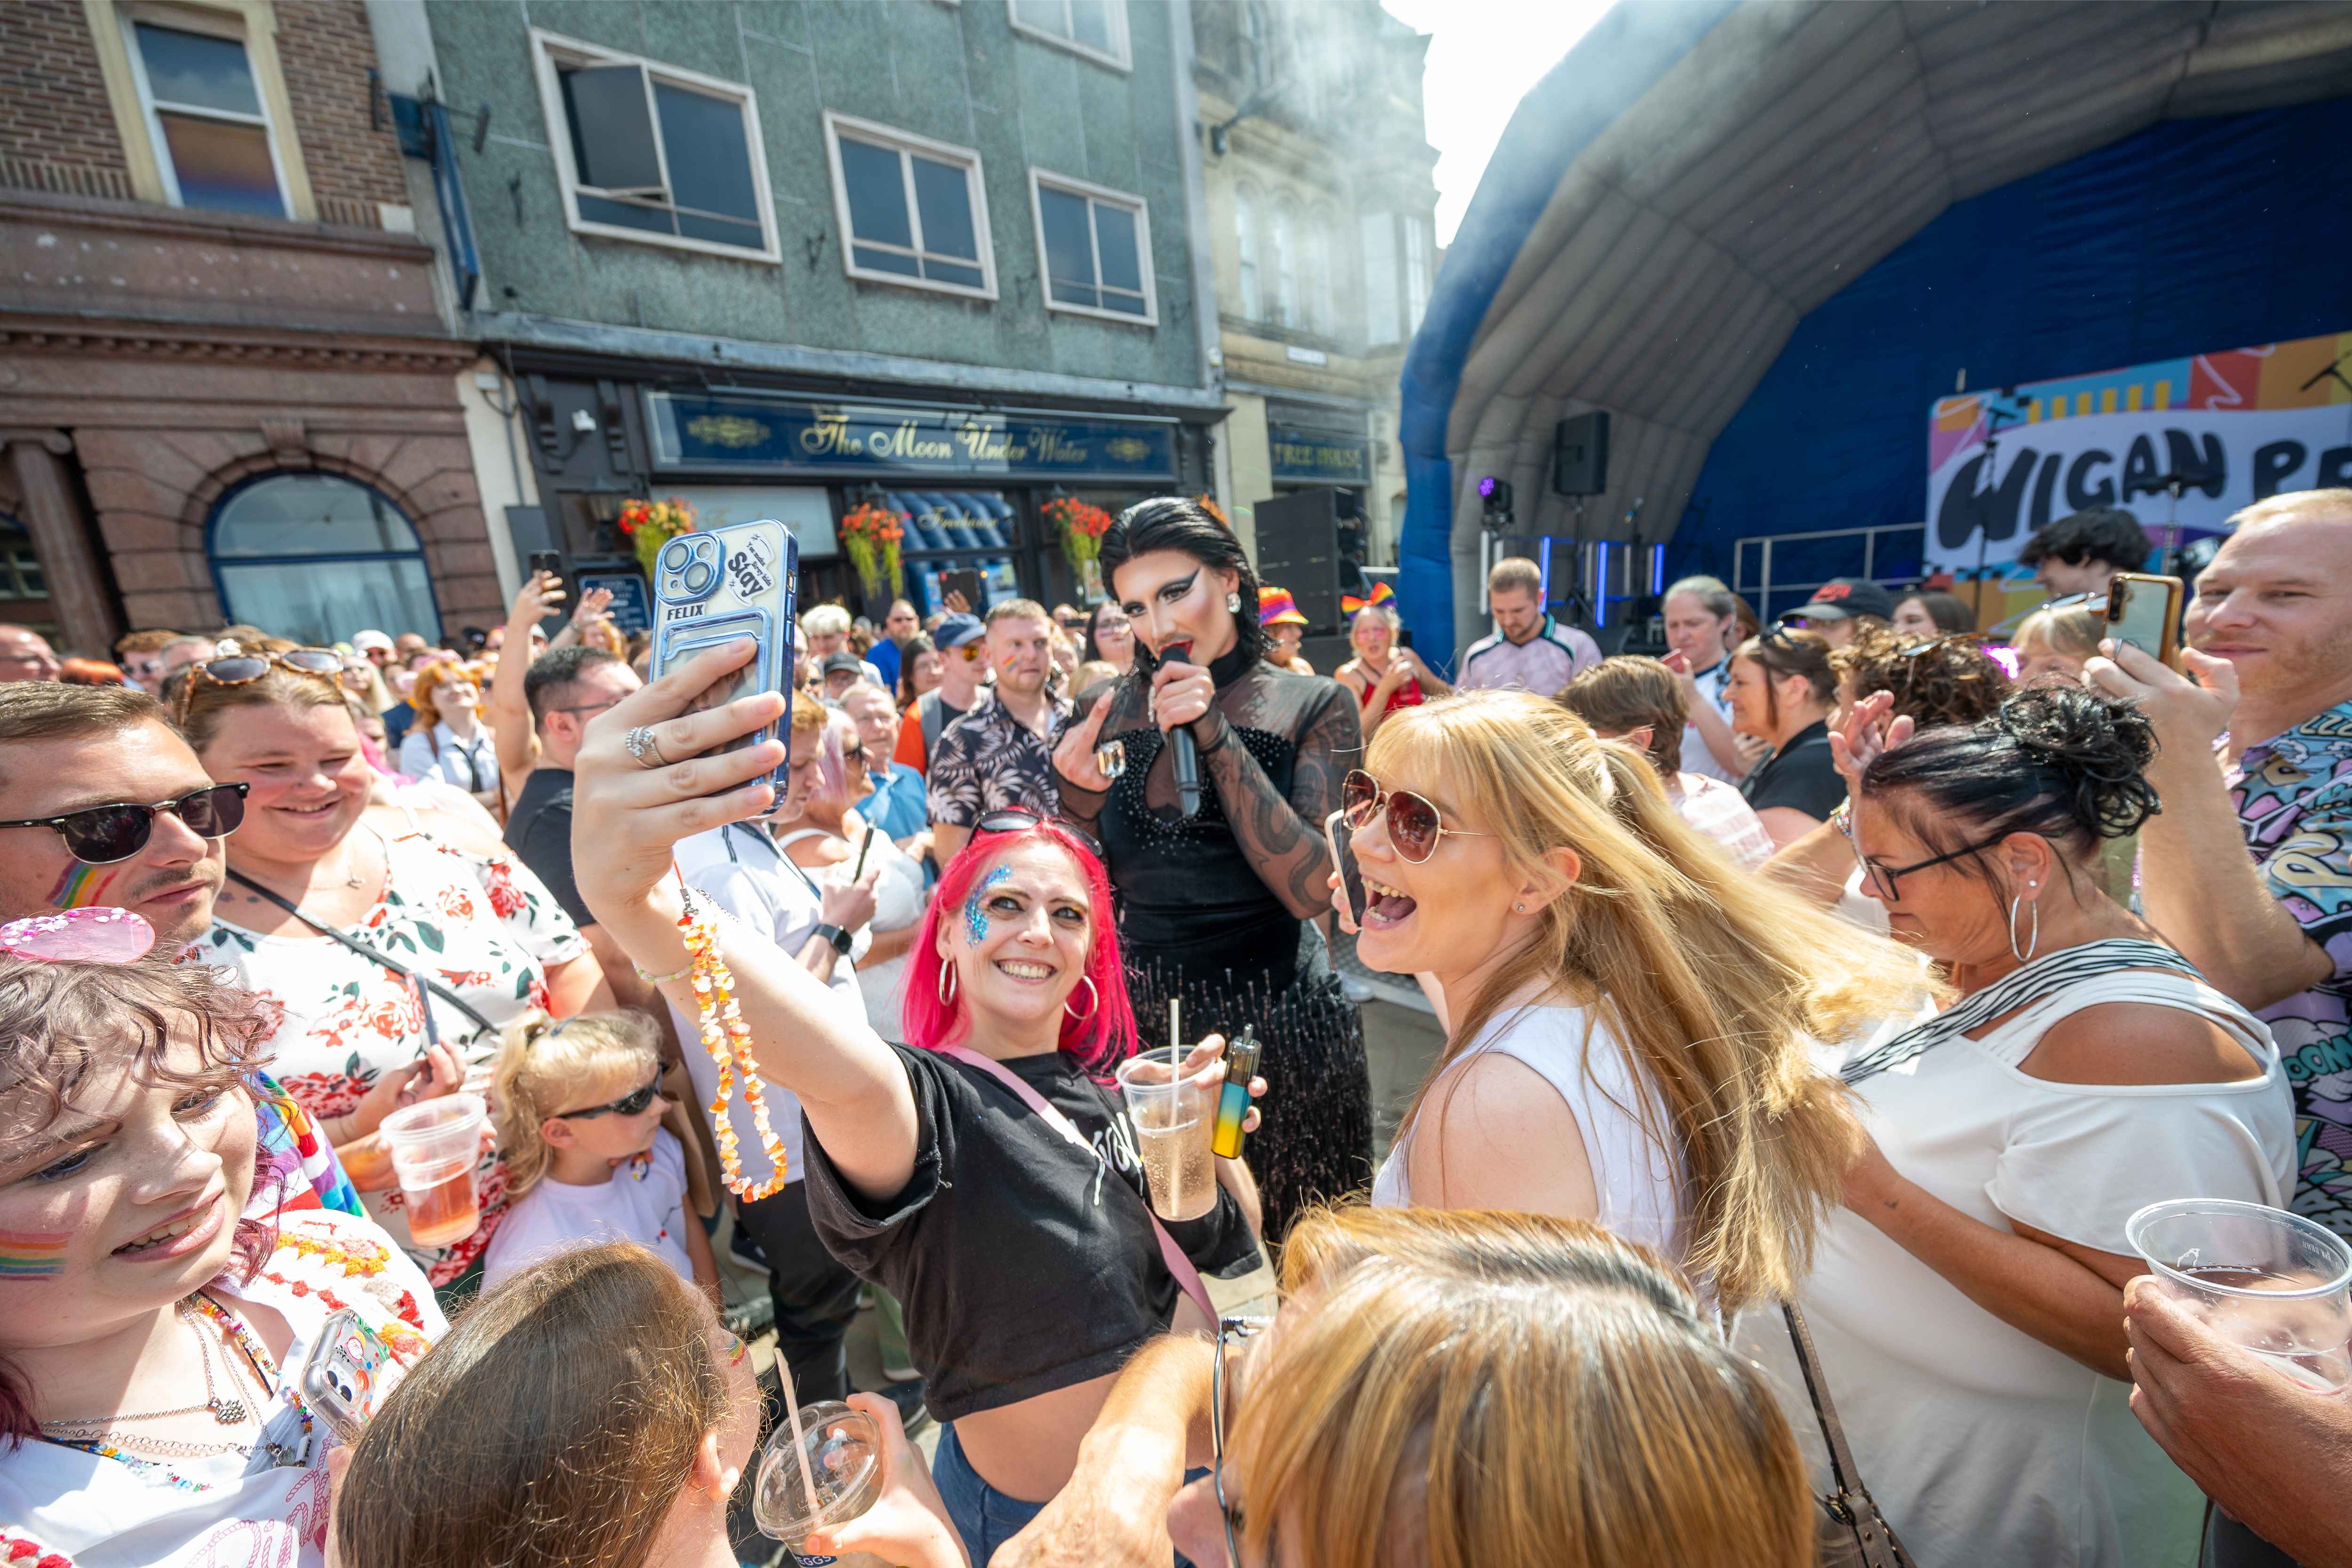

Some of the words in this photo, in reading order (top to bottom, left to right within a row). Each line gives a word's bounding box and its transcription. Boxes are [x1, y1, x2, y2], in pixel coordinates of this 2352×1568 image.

[800, 414, 864, 456] The
[868, 419, 954, 459] Moon
[955, 422, 1030, 460] Under
[1026, 426, 1088, 463] Water
[1937, 429, 2226, 549] WIGAN
[729, 551, 763, 597] Stay
[667, 604, 704, 621] FELIX
